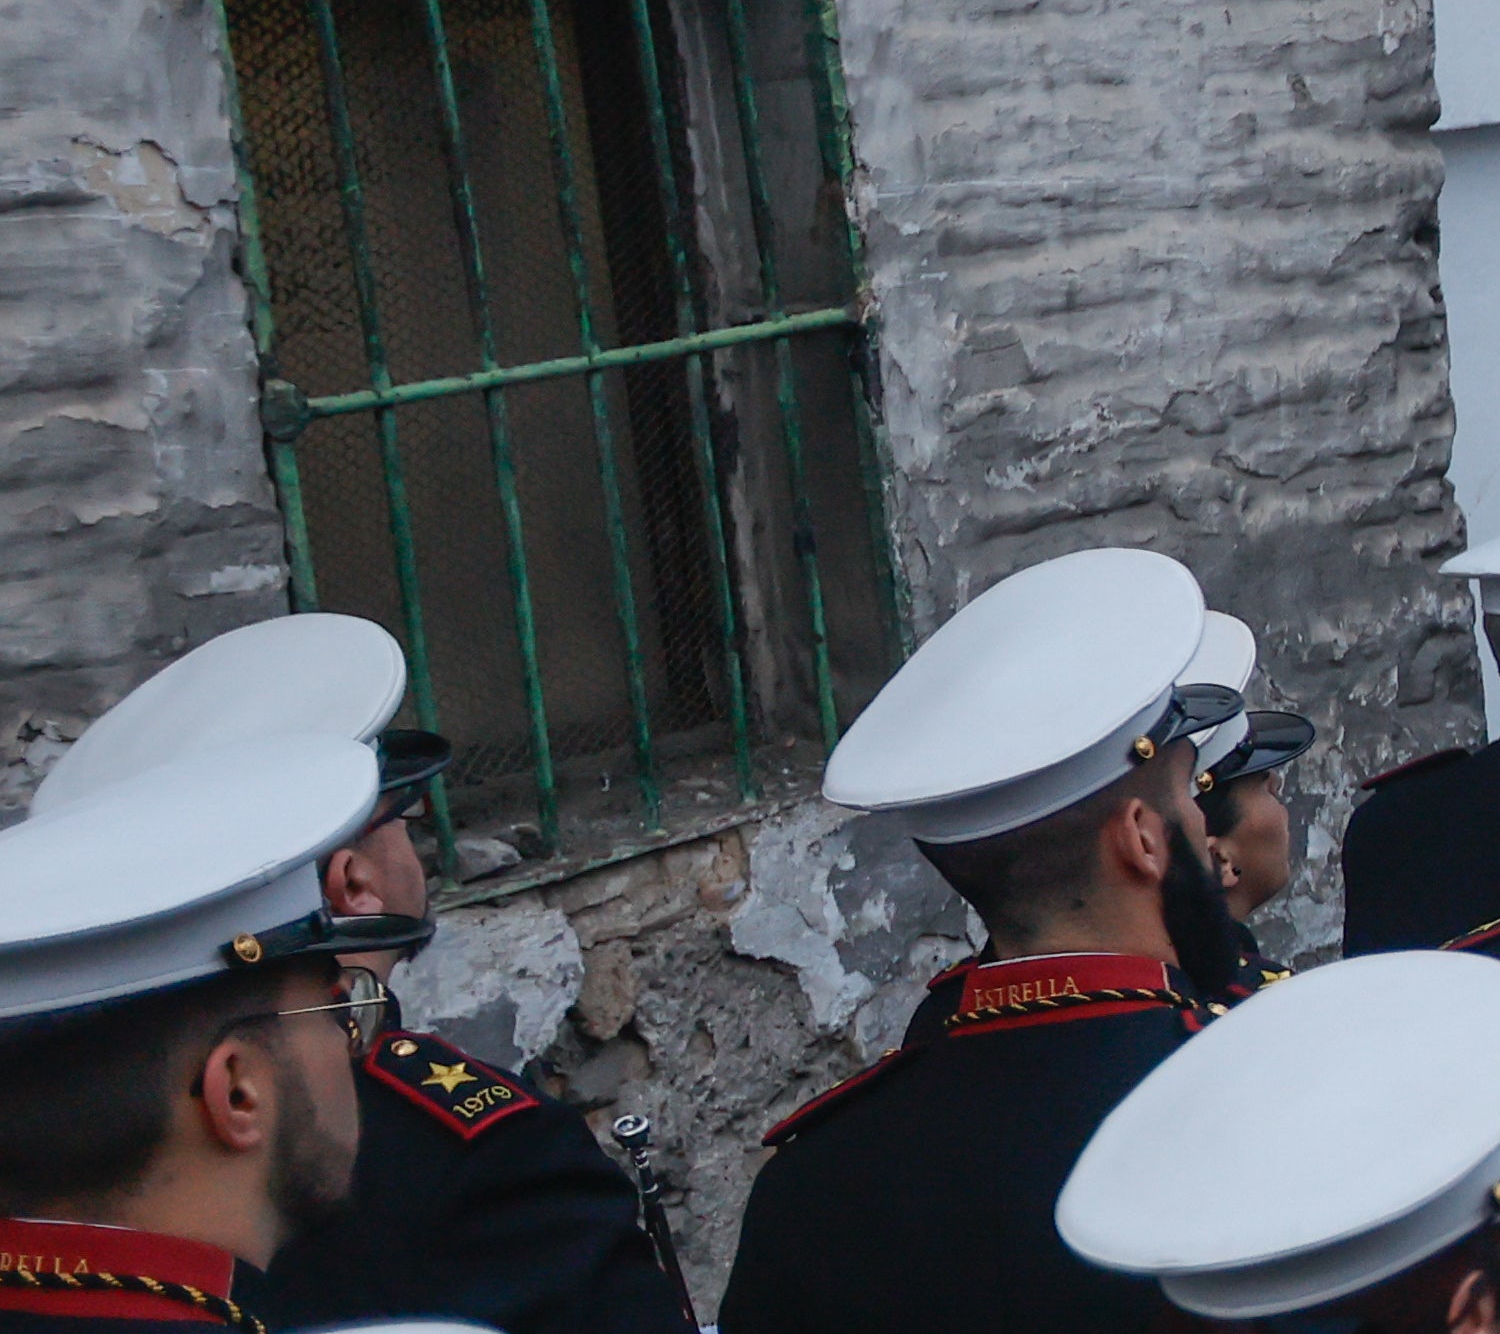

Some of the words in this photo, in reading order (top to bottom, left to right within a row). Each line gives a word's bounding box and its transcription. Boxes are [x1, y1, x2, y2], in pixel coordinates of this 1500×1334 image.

[974, 976, 1079, 1011] ESTRELLA
[452, 1084, 513, 1119] 1979
[0, 1252, 89, 1275] RELLA
